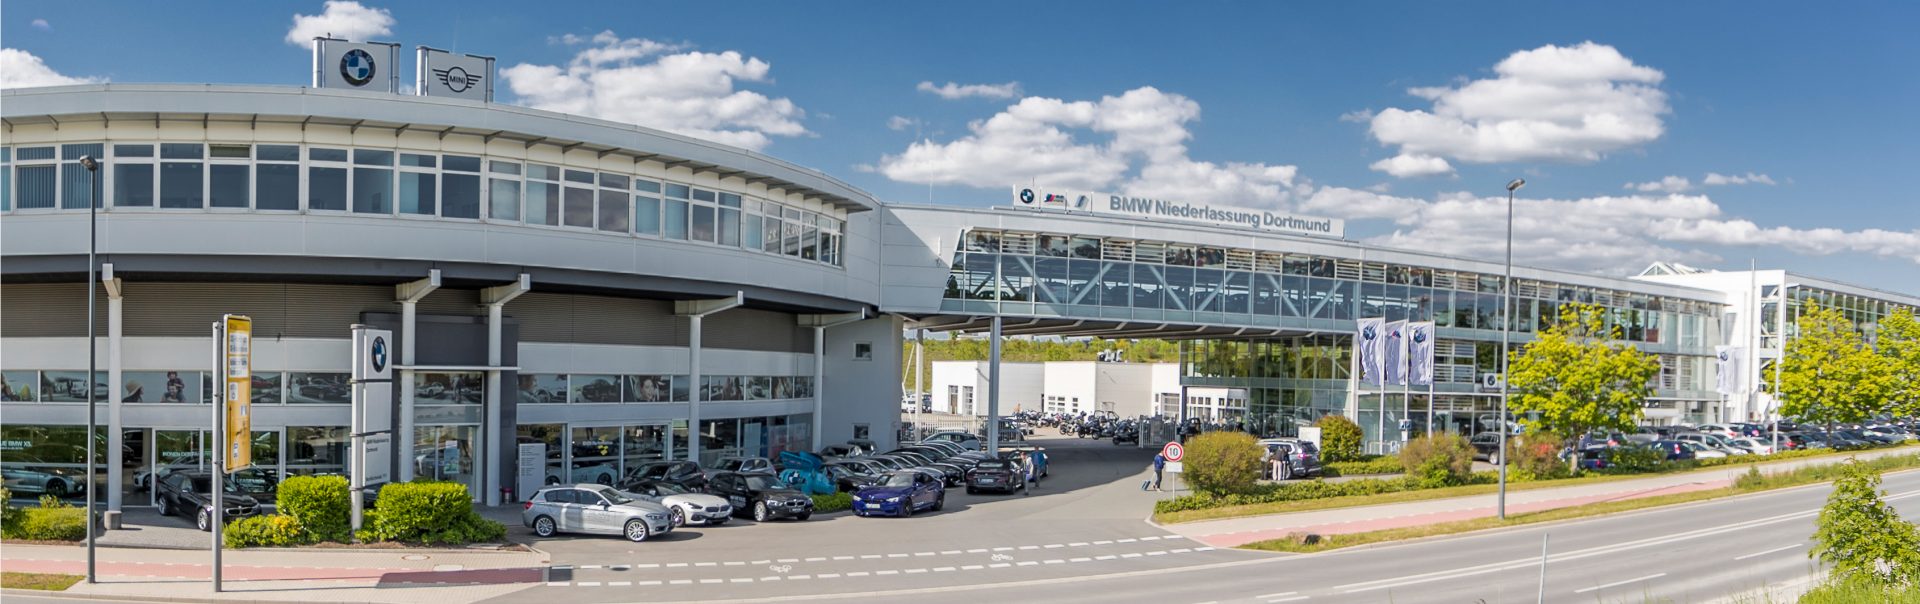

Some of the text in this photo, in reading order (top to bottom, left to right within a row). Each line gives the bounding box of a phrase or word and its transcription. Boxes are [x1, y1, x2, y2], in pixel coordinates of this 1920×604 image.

[449, 75, 466, 84] MINI
[1110, 195, 1331, 232] BMW Niederlassung Dortmund
[1169, 448, 1178, 456] 10
